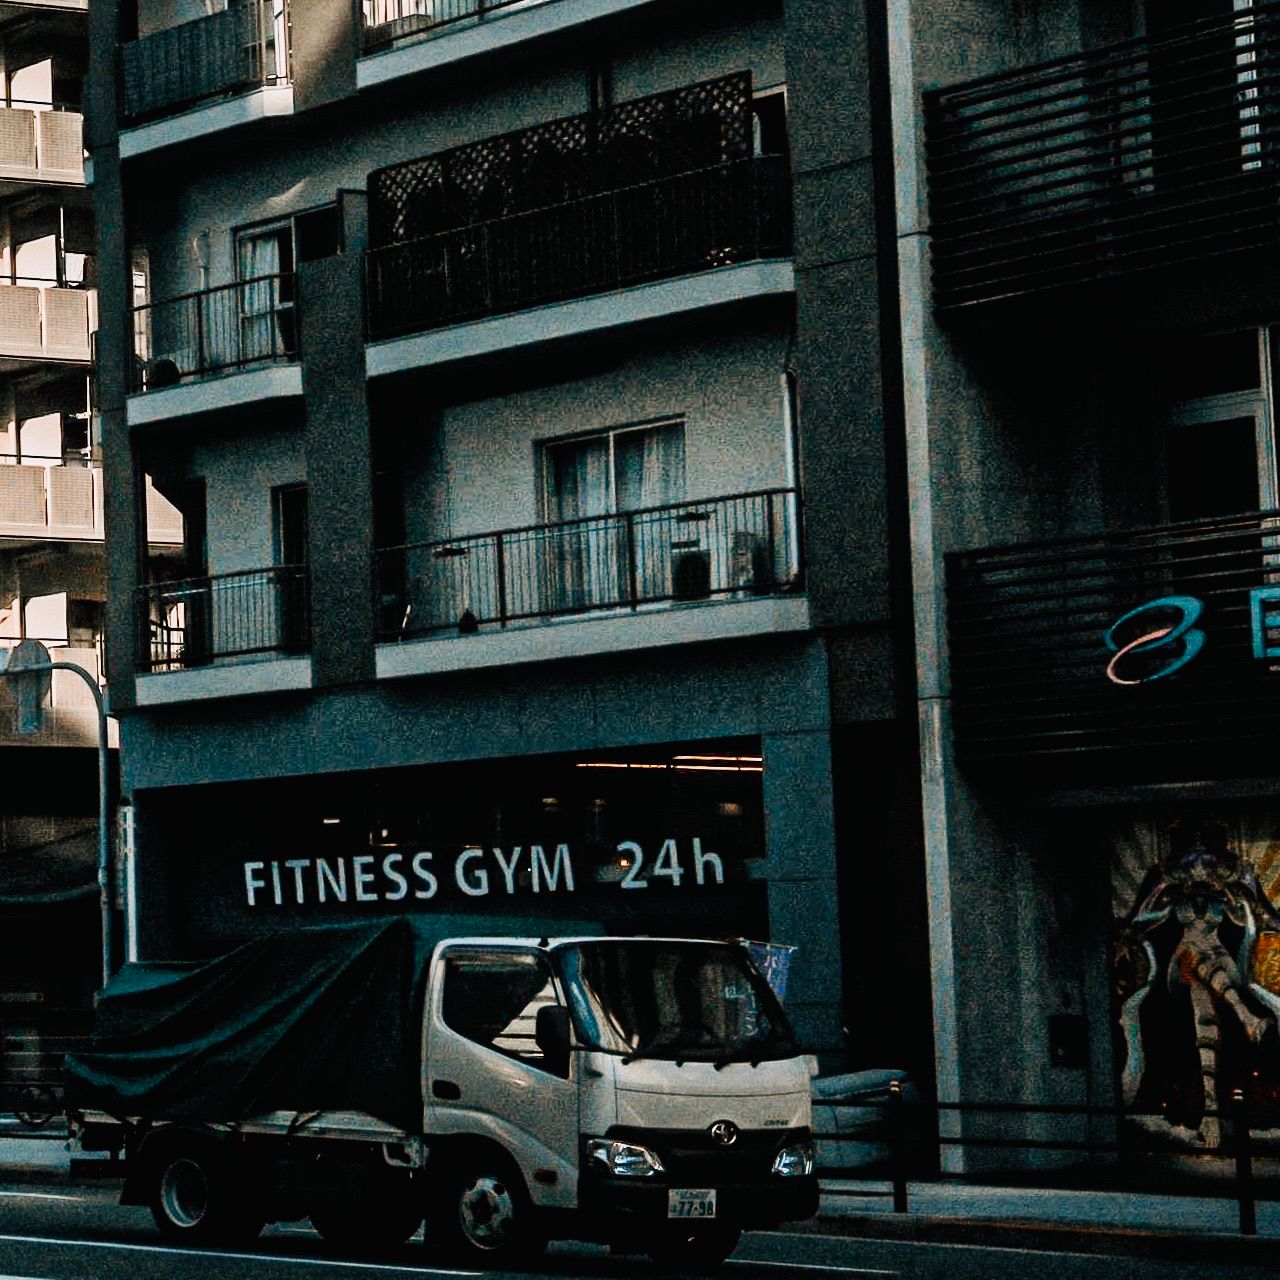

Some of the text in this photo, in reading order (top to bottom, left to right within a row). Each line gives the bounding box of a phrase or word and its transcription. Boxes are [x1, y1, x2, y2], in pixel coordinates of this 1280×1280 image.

[244, 837, 726, 907] FITNESS GYM 24h
